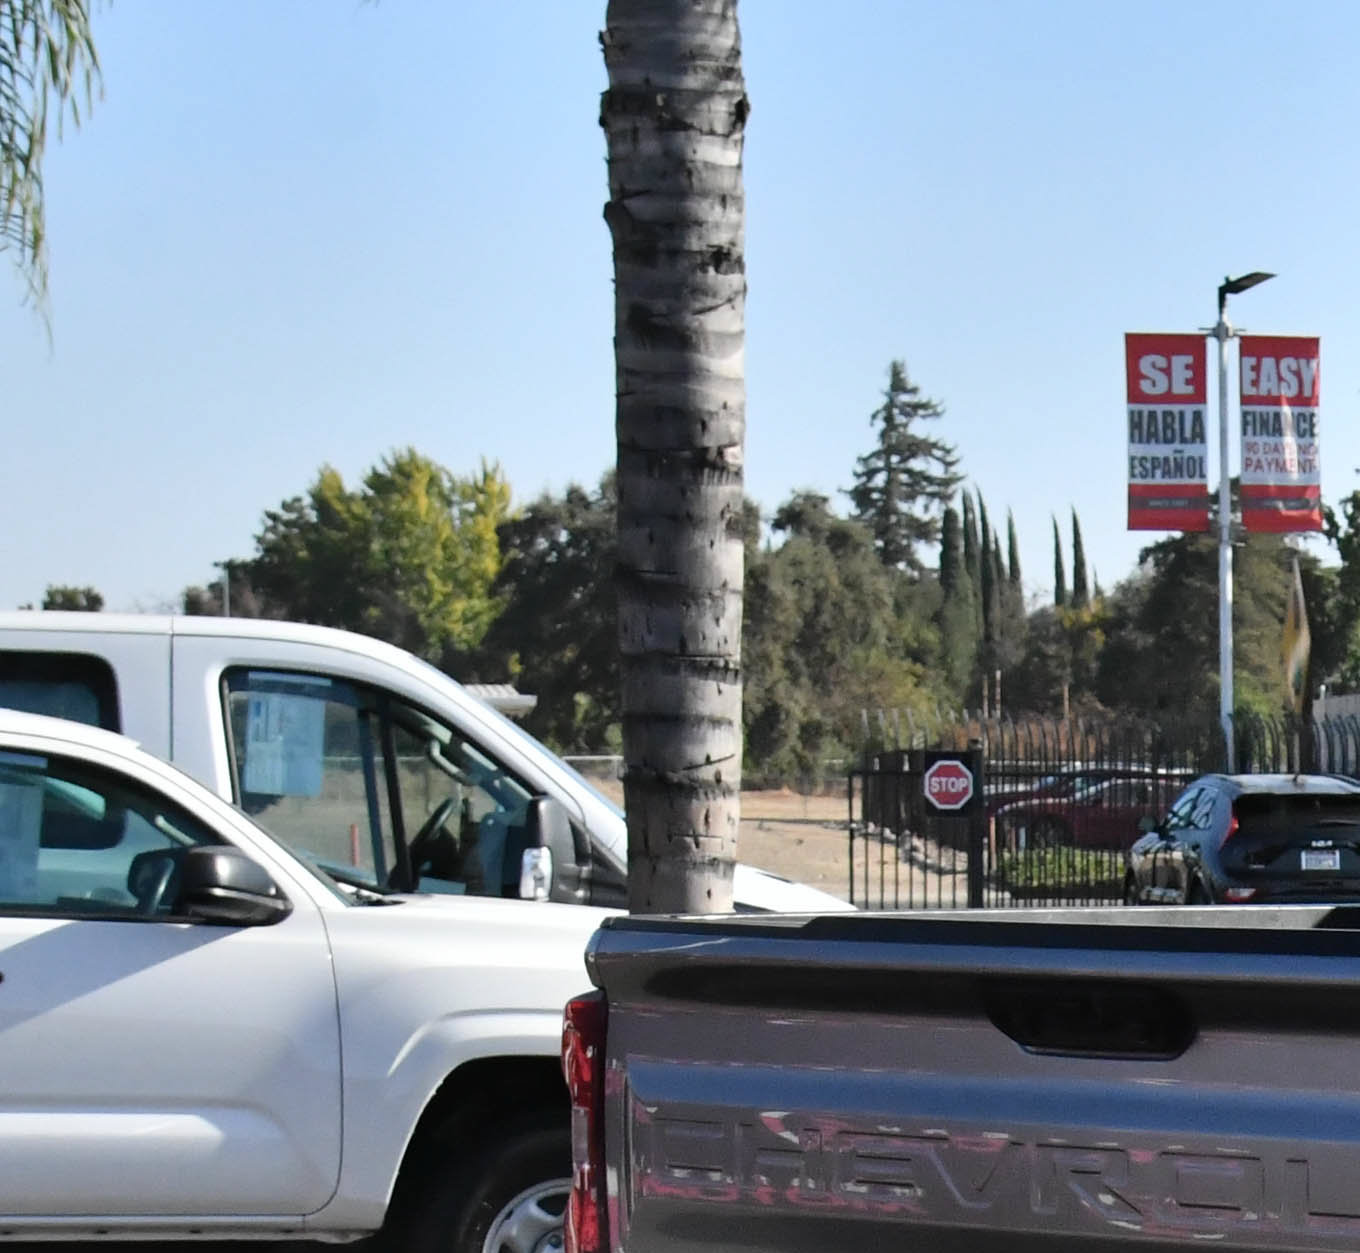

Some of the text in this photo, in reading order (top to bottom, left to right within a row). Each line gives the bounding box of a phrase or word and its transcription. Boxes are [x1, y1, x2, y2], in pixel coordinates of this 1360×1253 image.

[1139, 354, 1195, 395] SE
[1241, 357, 1318, 398] EASY
[1130, 410, 1206, 444] HABLA
[1130, 449, 1206, 479] ESPAÑOL
[930, 777, 968, 793] STOP
